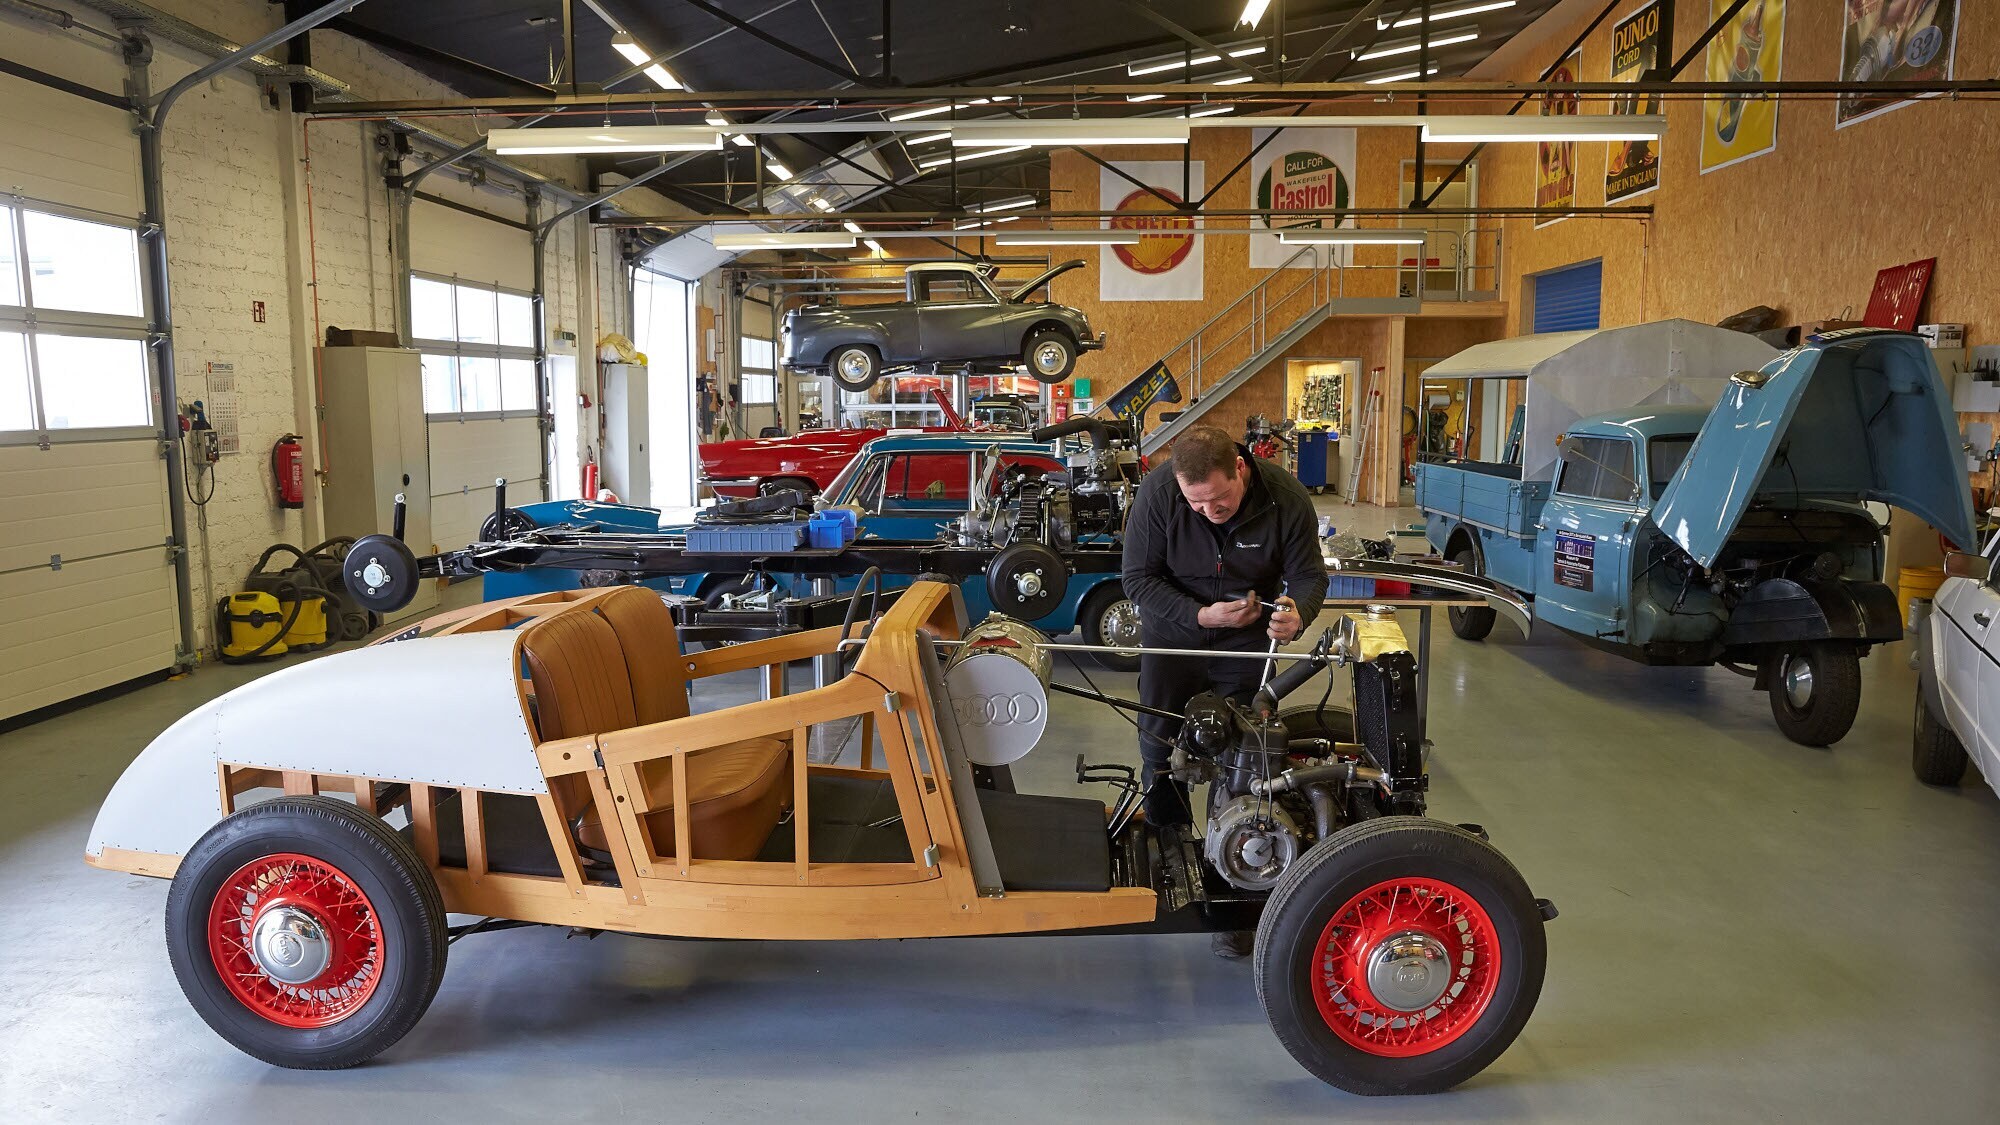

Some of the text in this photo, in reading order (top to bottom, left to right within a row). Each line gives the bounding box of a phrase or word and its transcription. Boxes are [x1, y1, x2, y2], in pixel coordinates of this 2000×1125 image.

[1617, 47, 1640, 69] CORD
[1910, 32, 1935, 60] 32
[1286, 156, 1323, 173] CALL FOR
[1273, 173, 1333, 210] Castrol
[1286, 174, 1327, 187] WAKEFIELD
[1606, 167, 1658, 195] MADE IN ENGLAND
[1121, 215, 1185, 239] SHELL
[1118, 365, 1167, 421] HAZET
